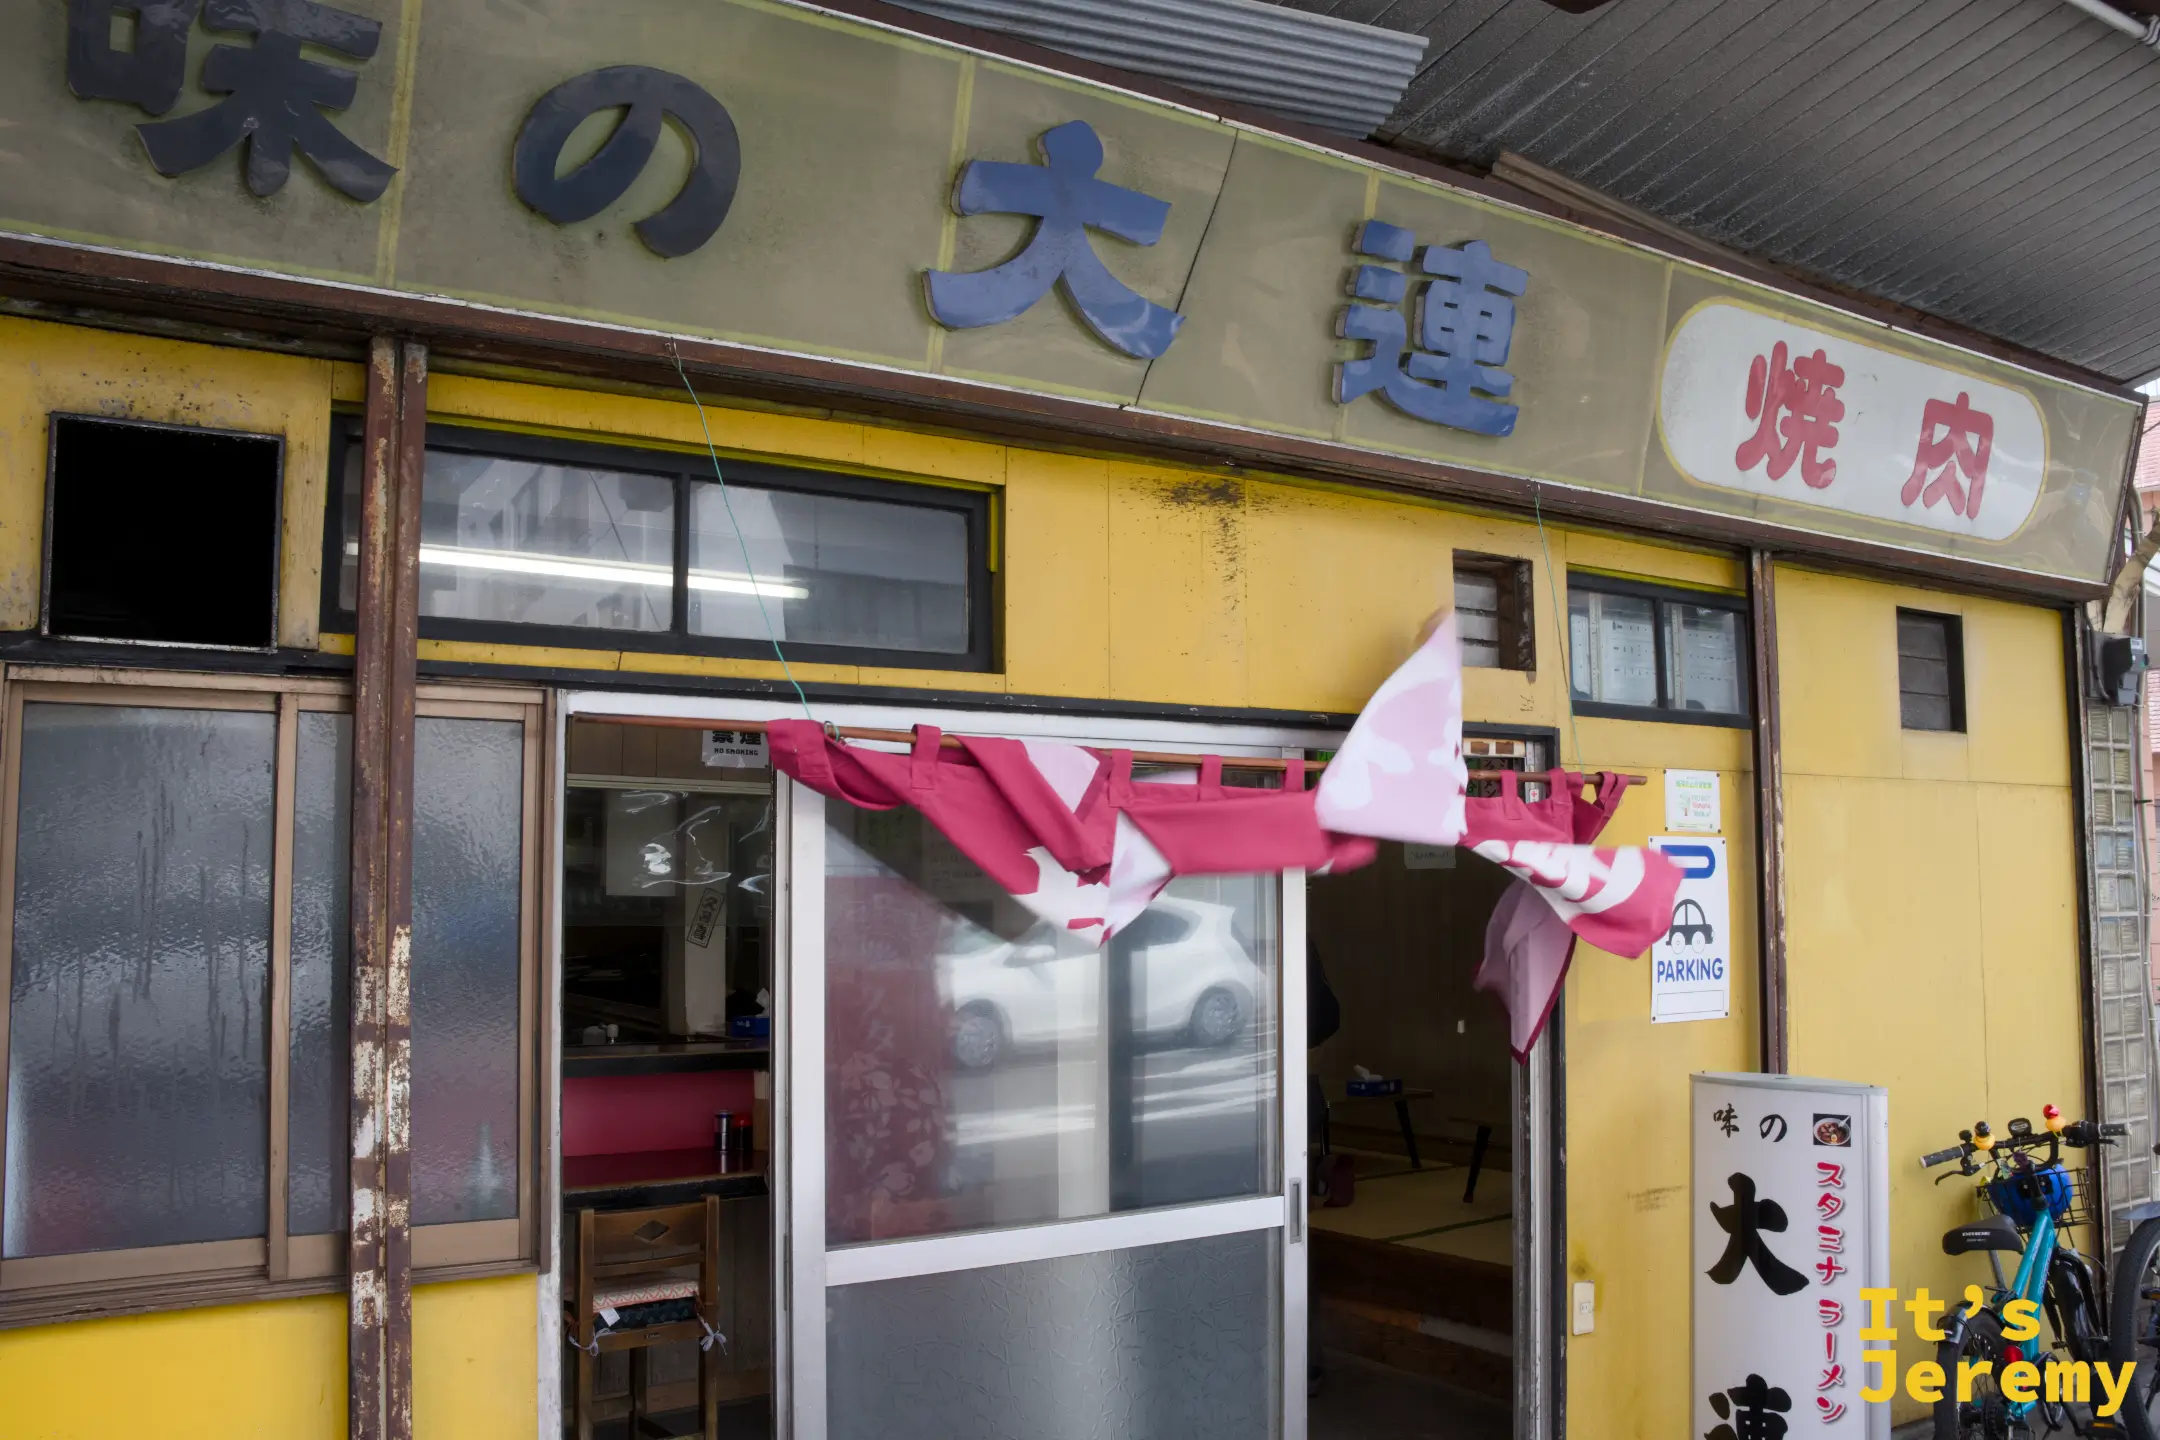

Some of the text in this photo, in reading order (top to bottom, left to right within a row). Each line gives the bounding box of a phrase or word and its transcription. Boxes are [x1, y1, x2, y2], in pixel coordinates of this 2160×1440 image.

[1735, 341, 1994, 519] 焼肉
[725, 748, 759, 756] SMOKING
[1657, 957, 1723, 983] PARKING
[1713, 1103, 1787, 1142] 味の
